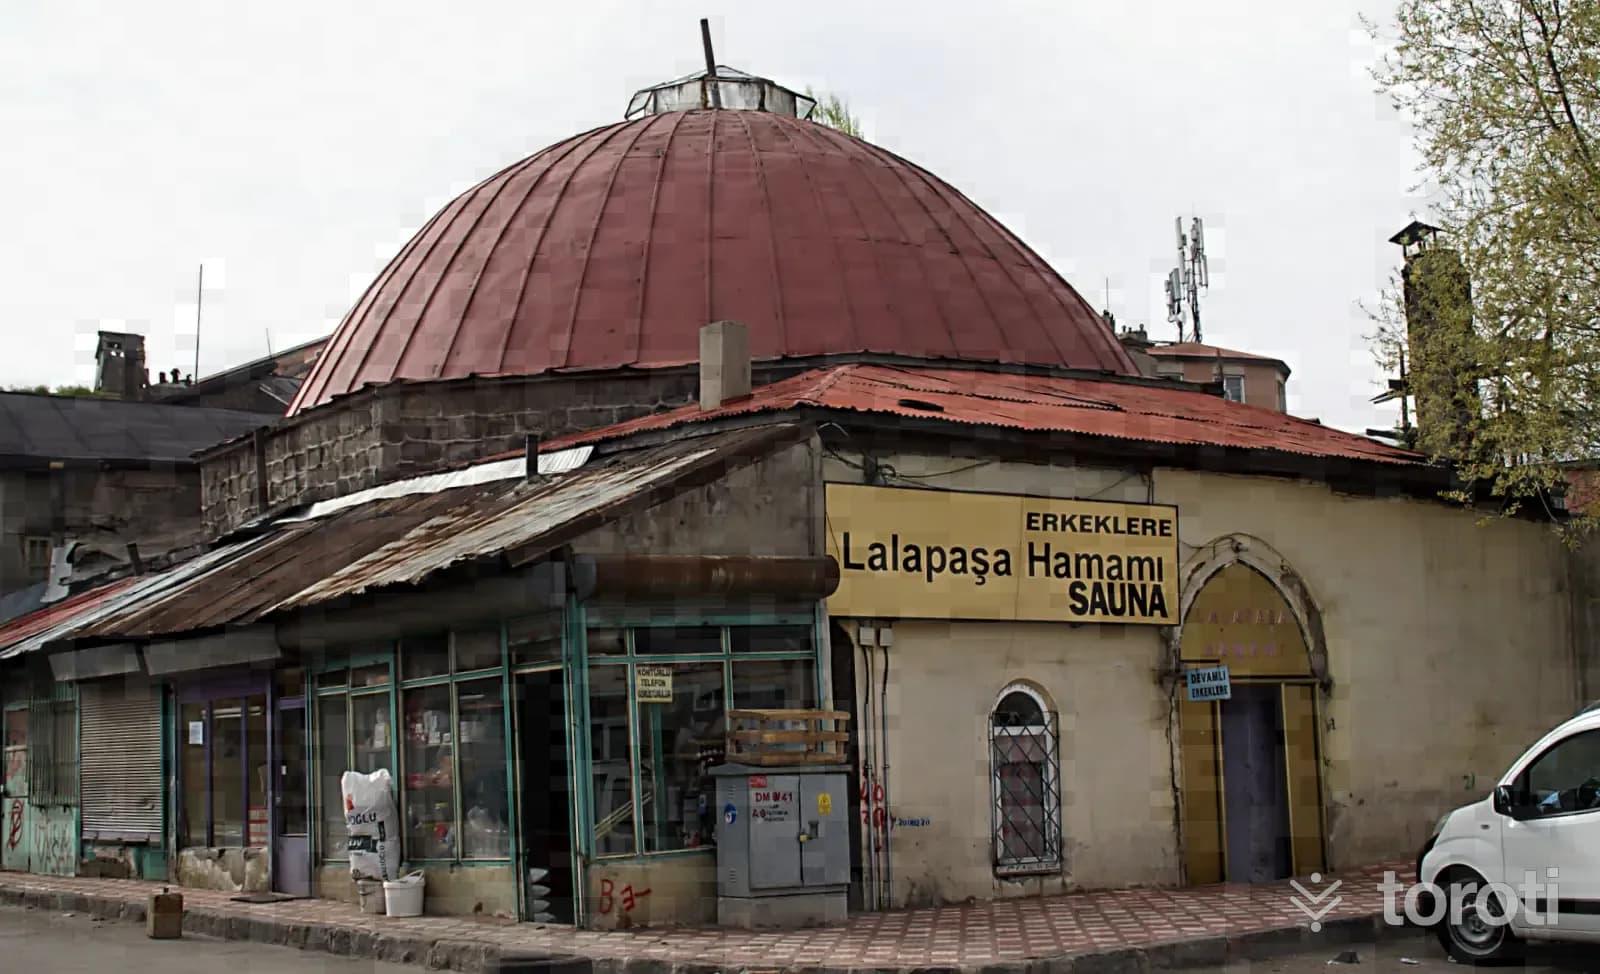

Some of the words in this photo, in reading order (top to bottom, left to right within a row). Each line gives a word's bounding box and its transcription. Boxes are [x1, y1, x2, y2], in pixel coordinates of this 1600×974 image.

[1026, 512, 1172, 537] ERKEKLERE
[843, 531, 1012, 585] Lalapaşa
[1028, 541, 1163, 582] Hamamı
[1069, 580, 1168, 618] SAUNA
[1191, 670, 1226, 684] DEVAMLI
[1192, 685, 1228, 698] ERKEKLERE
